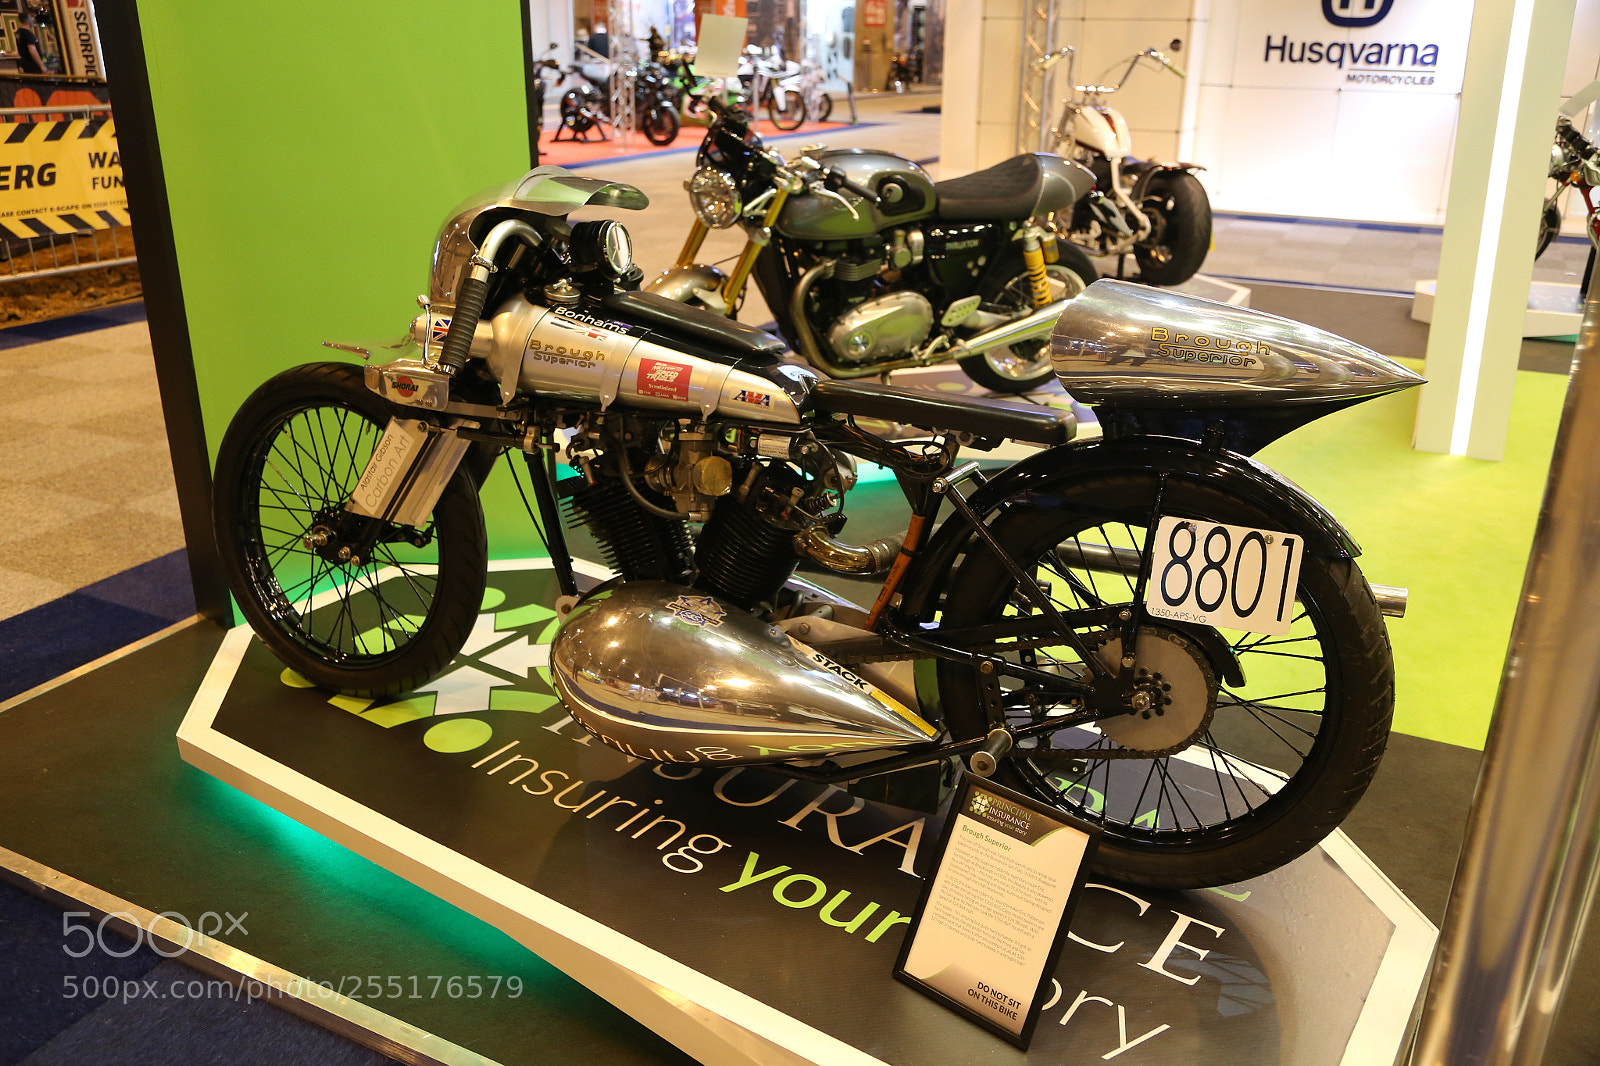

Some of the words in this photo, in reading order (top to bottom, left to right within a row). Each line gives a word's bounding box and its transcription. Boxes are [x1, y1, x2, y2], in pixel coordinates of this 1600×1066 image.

[1264, 35, 1439, 69] Husqvarna
[1346, 74, 1435, 85] MOTORCYCLES
[16, 207, 48, 216] CONTACT
[555, 306, 631, 334] Bonhams
[530, 339, 605, 361] Brough
[1151, 327, 1270, 356] Brough
[1157, 343, 1257, 367] Superior
[533, 351, 596, 368] Superior
[732, 390, 770, 407] AMA
[360, 462, 379, 491] Alastair
[375, 434, 394, 462] Gibson
[365, 457, 399, 508] Carbon
[395, 435, 411, 459] Art
[1161, 521, 1295, 623] 8801
[1151, 607, 1207, 624] 1350-APS-VG
[812, 653, 869, 690] STACK
[988, 806, 1031, 830] INSURANCE
[991, 798, 1033, 821] PRINCIPAL
[471, 740, 732, 874] Insuring
[719, 851, 912, 943] your
[962, 824, 984, 840] Brough
[984, 834, 1012, 852] Superior
[967, 988, 981, 1000] ON
[981, 994, 998, 1010] THIS
[998, 1005, 1018, 1021] BIKE
[977, 981, 990, 993] DO
[990, 988, 1008, 1003] NOT
[1008, 998, 1021, 1009] SIT
